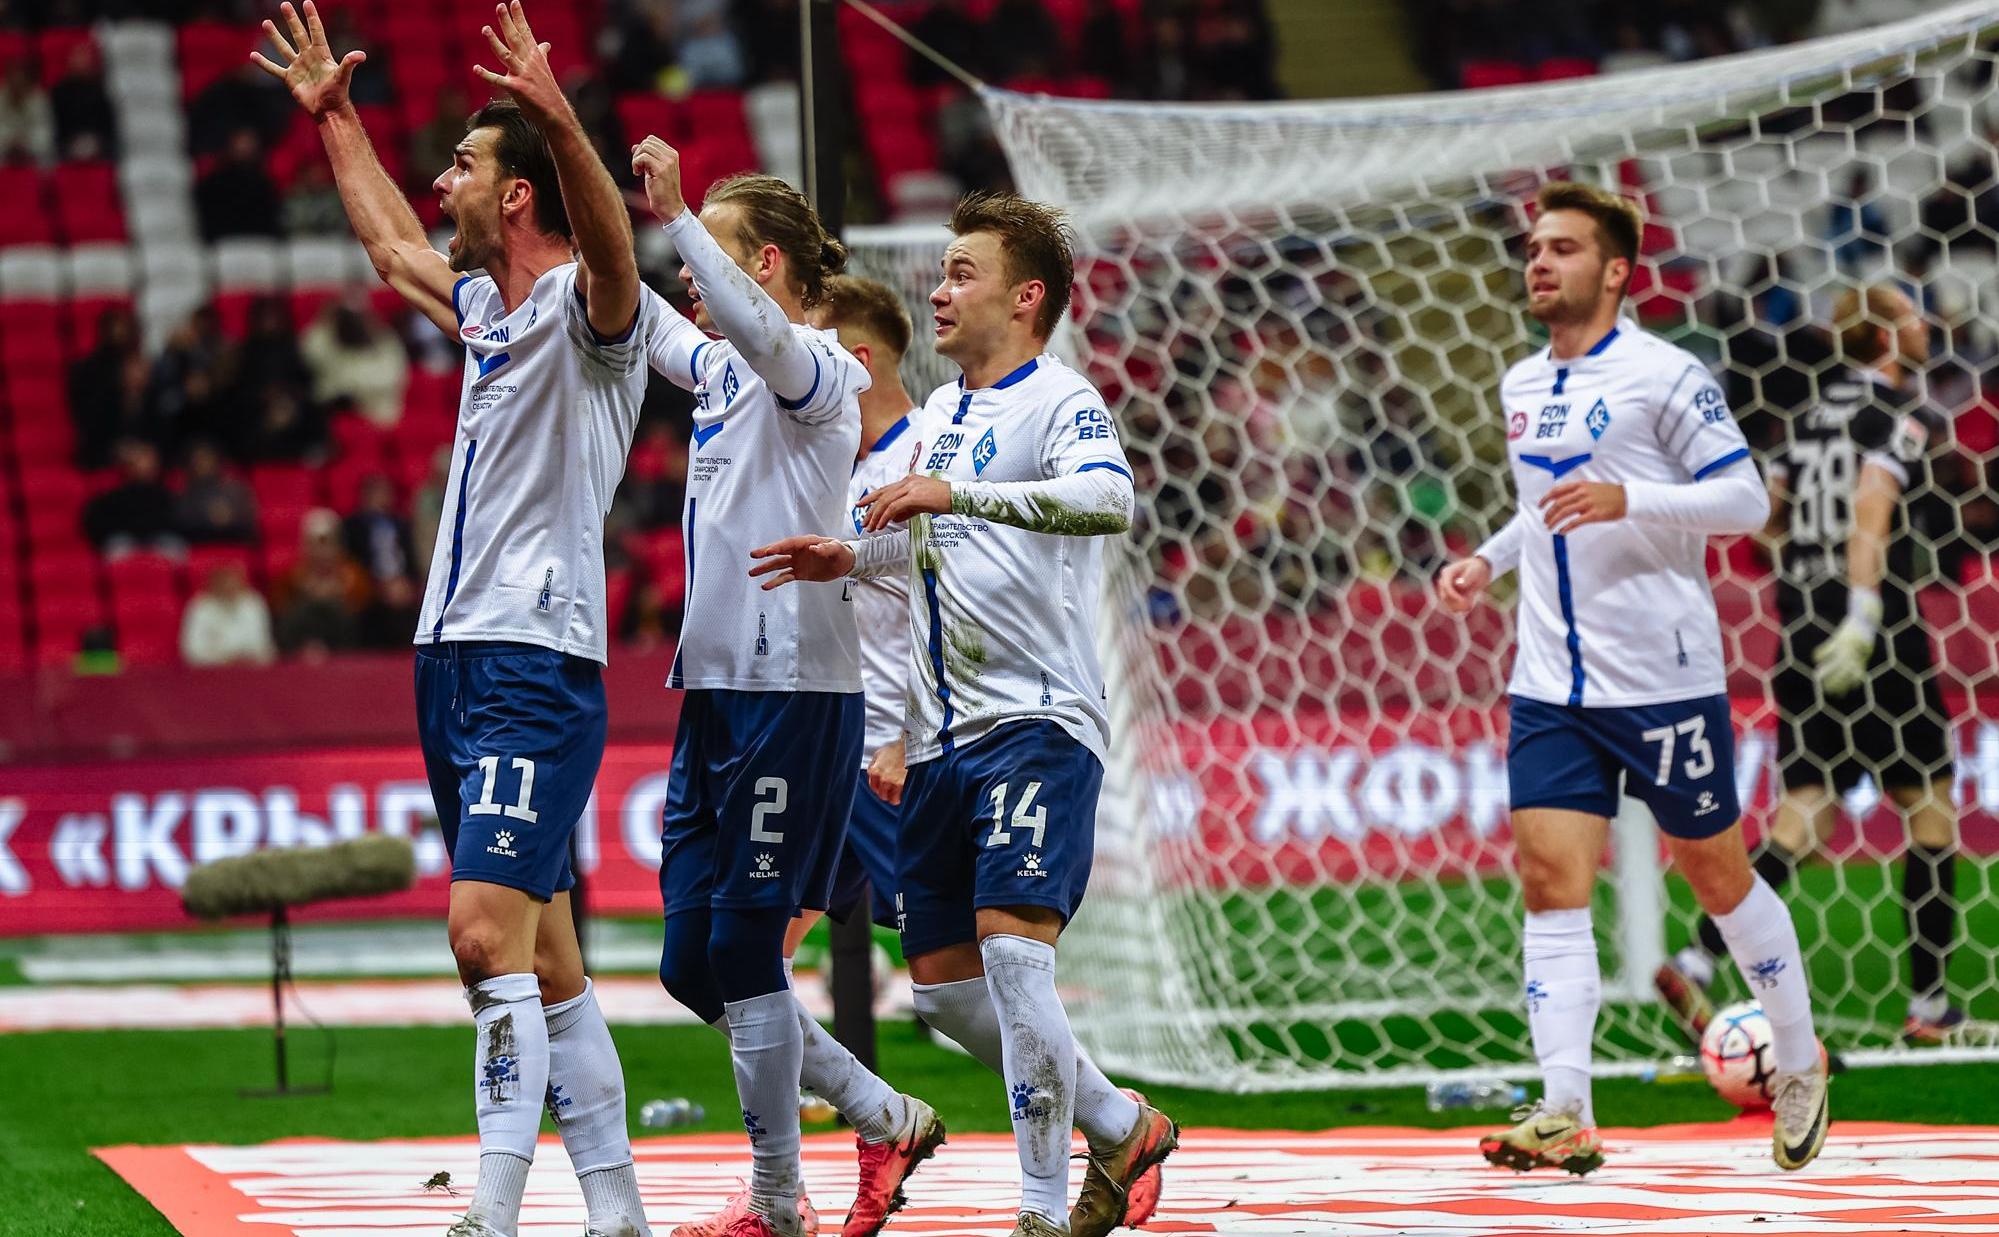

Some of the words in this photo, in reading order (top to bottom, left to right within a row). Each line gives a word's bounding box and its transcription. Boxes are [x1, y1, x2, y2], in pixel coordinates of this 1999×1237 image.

[697, 392, 710, 410] ET
[1541, 404, 1571, 420] FON
[1703, 405, 1725, 424] BE
[1537, 422, 1567, 439] BET
[932, 433, 964, 450] FON
[926, 453, 957, 470] BET
[1642, 714, 1714, 786] 73
[468, 756, 538, 824] 11
[750, 776, 788, 844] 2
[986, 782, 1047, 848] 14
[486, 846, 518, 857] KELME
[749, 870, 781, 878] KELME
[1017, 869, 1048, 878] KELME
[480, 1074, 520, 1087] KEME
[1012, 1106, 1044, 1121] ELME
